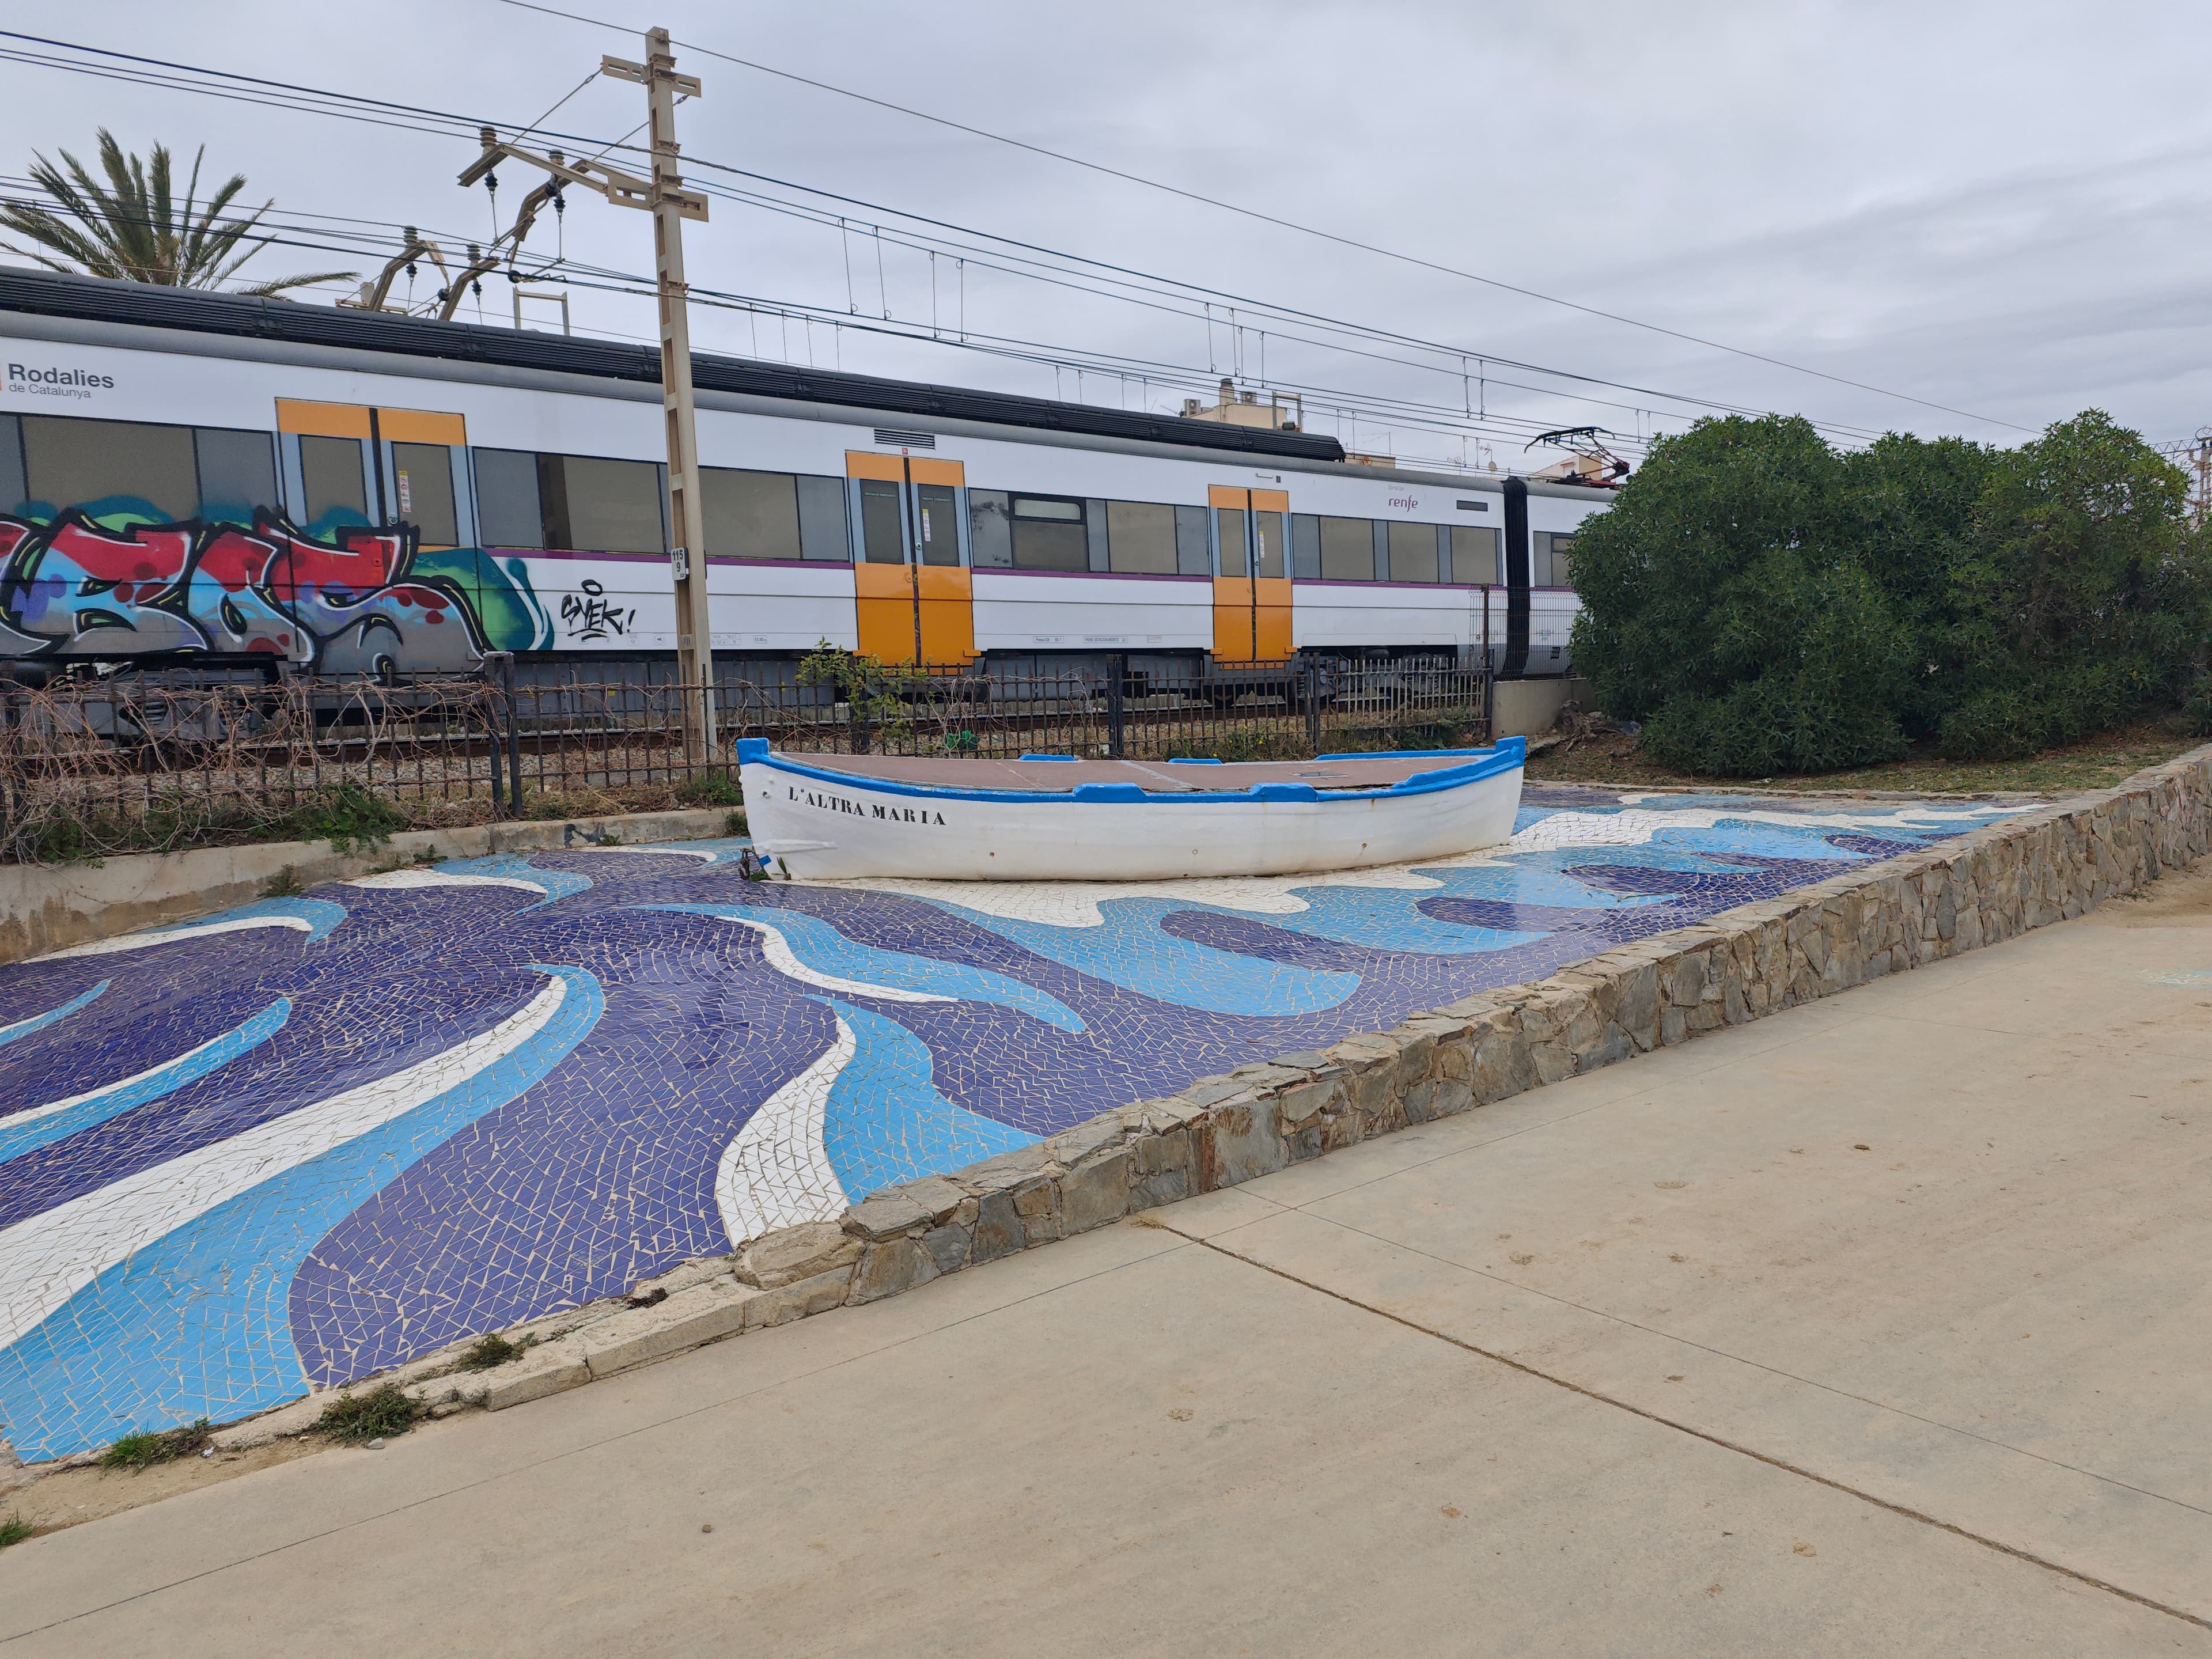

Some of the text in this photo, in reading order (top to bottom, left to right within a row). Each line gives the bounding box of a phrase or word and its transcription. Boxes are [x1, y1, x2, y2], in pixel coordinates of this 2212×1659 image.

[8, 363, 114, 388] Rodalies
[9, 383, 92, 399] de Catalunya
[1388, 495, 1418, 512] renfe
[672, 550, 683, 560] 115
[676, 562, 681, 572] 9
[789, 786, 946, 825] L'ALTRA MARIA
